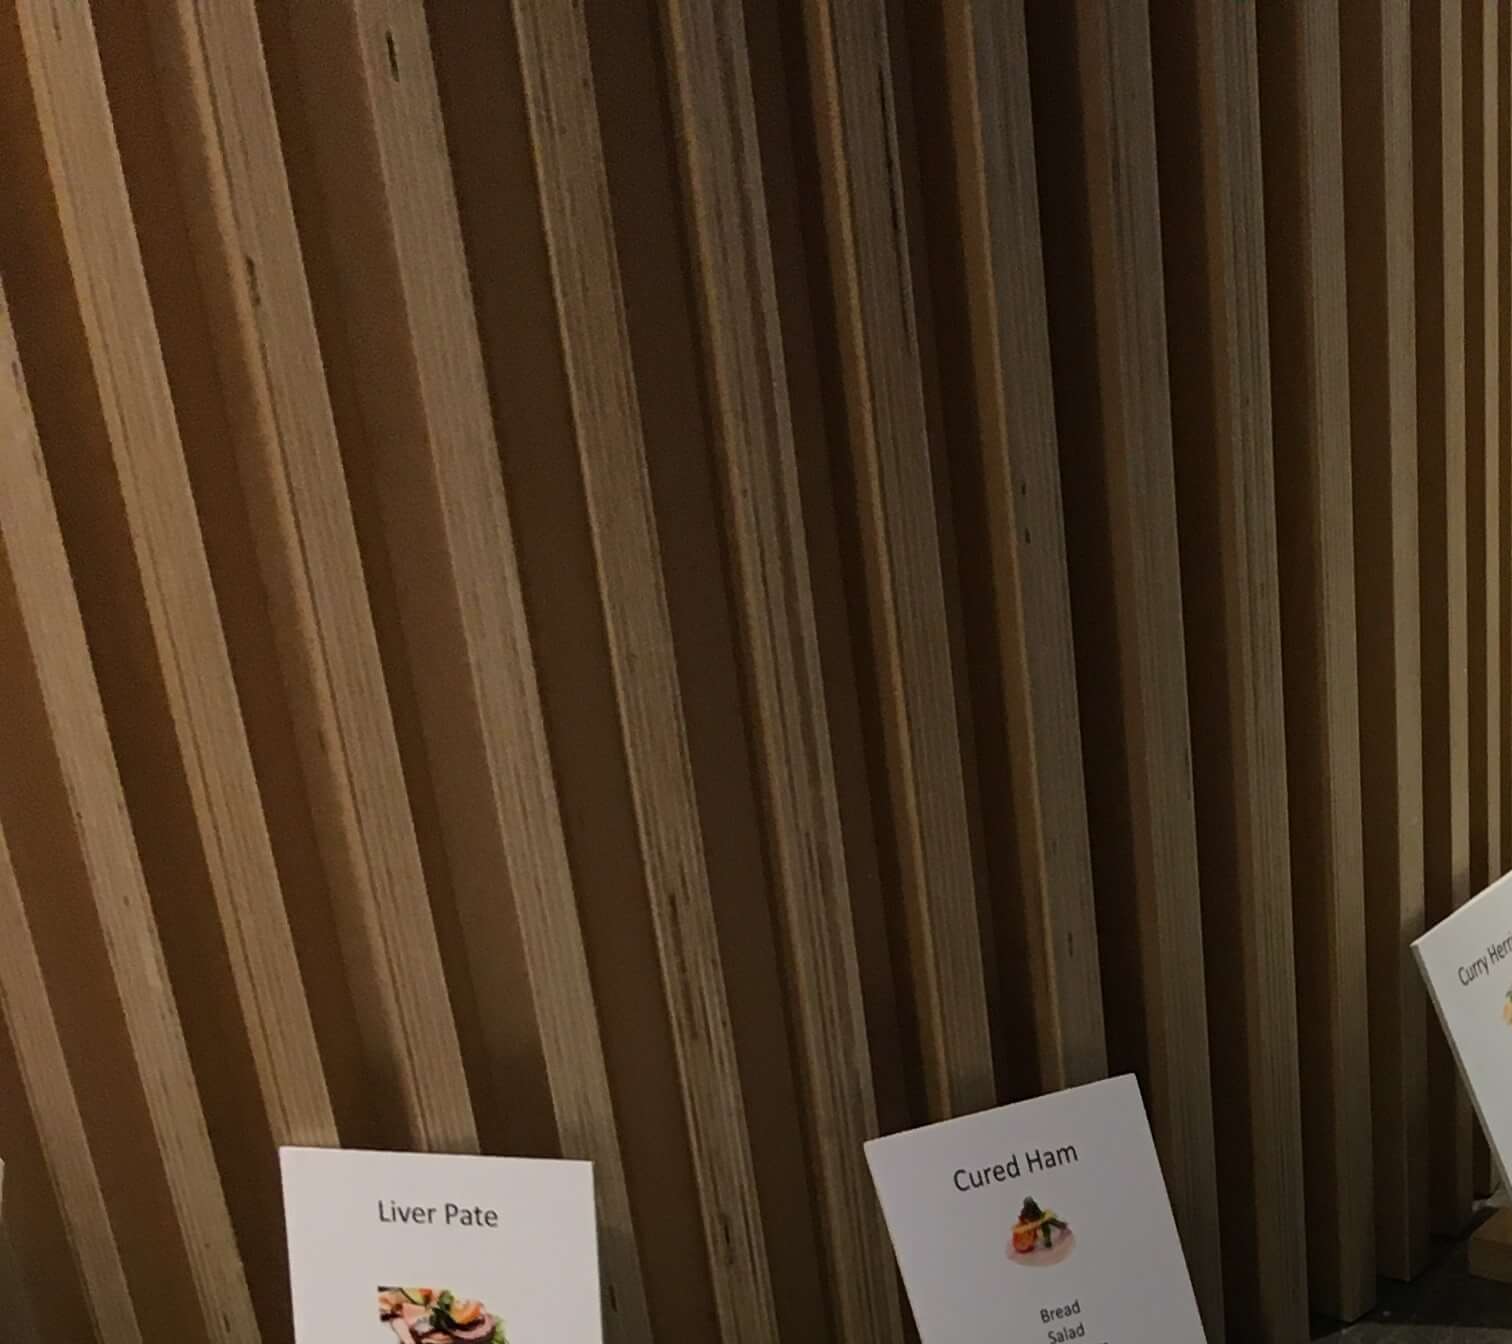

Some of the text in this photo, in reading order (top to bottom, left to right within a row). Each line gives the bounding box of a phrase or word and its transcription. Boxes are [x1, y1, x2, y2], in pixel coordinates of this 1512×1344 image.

[1458, 956, 1489, 986] Curry
[953, 1145, 1079, 1192] Cured Ham
[378, 1199, 499, 1228] Liver Pate
[1040, 1299, 1081, 1324] Bread
